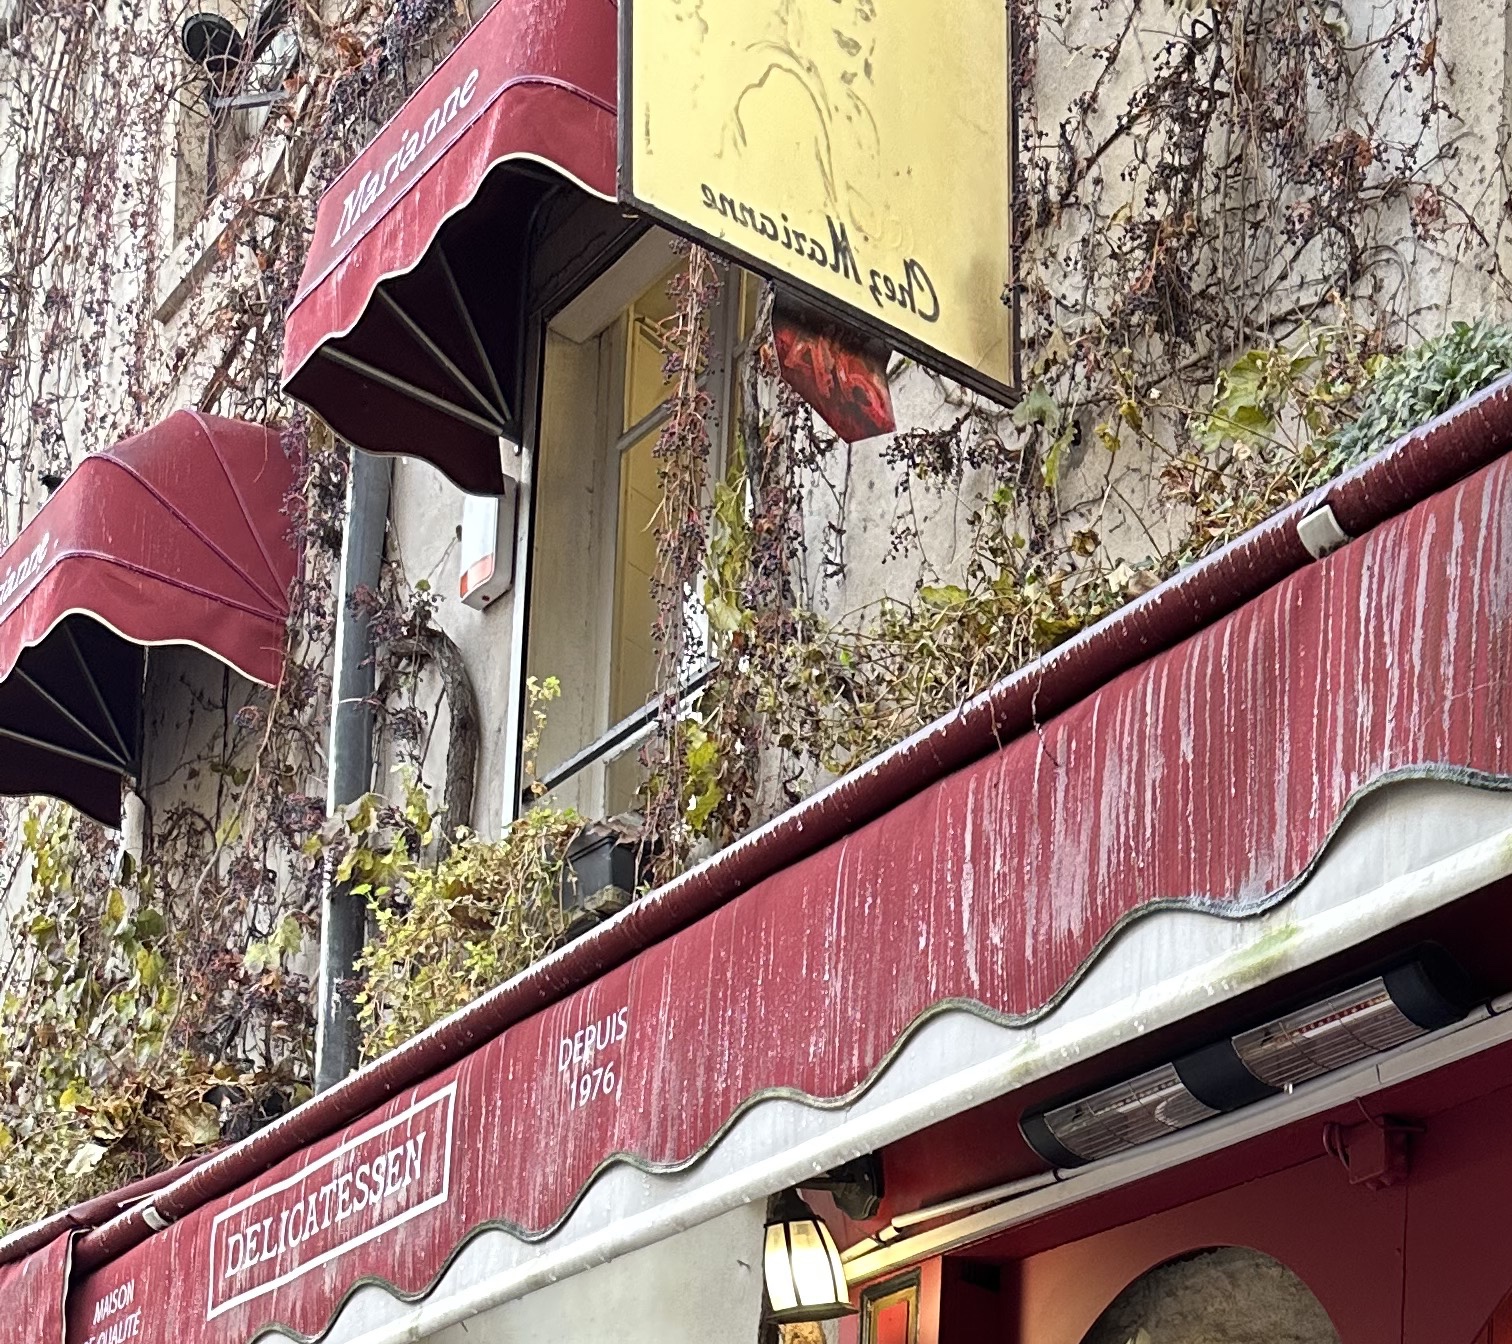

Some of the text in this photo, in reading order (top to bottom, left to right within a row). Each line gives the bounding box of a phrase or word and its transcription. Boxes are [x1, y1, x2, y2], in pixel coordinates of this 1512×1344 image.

[331, 68, 479, 247] Marianne
[558, 1006, 628, 1072] DEPUIS
[570, 1061, 615, 1111] 1976
[225, 1132, 427, 1278] DELICATESSEN
[92, 1279, 135, 1326] MAISON
